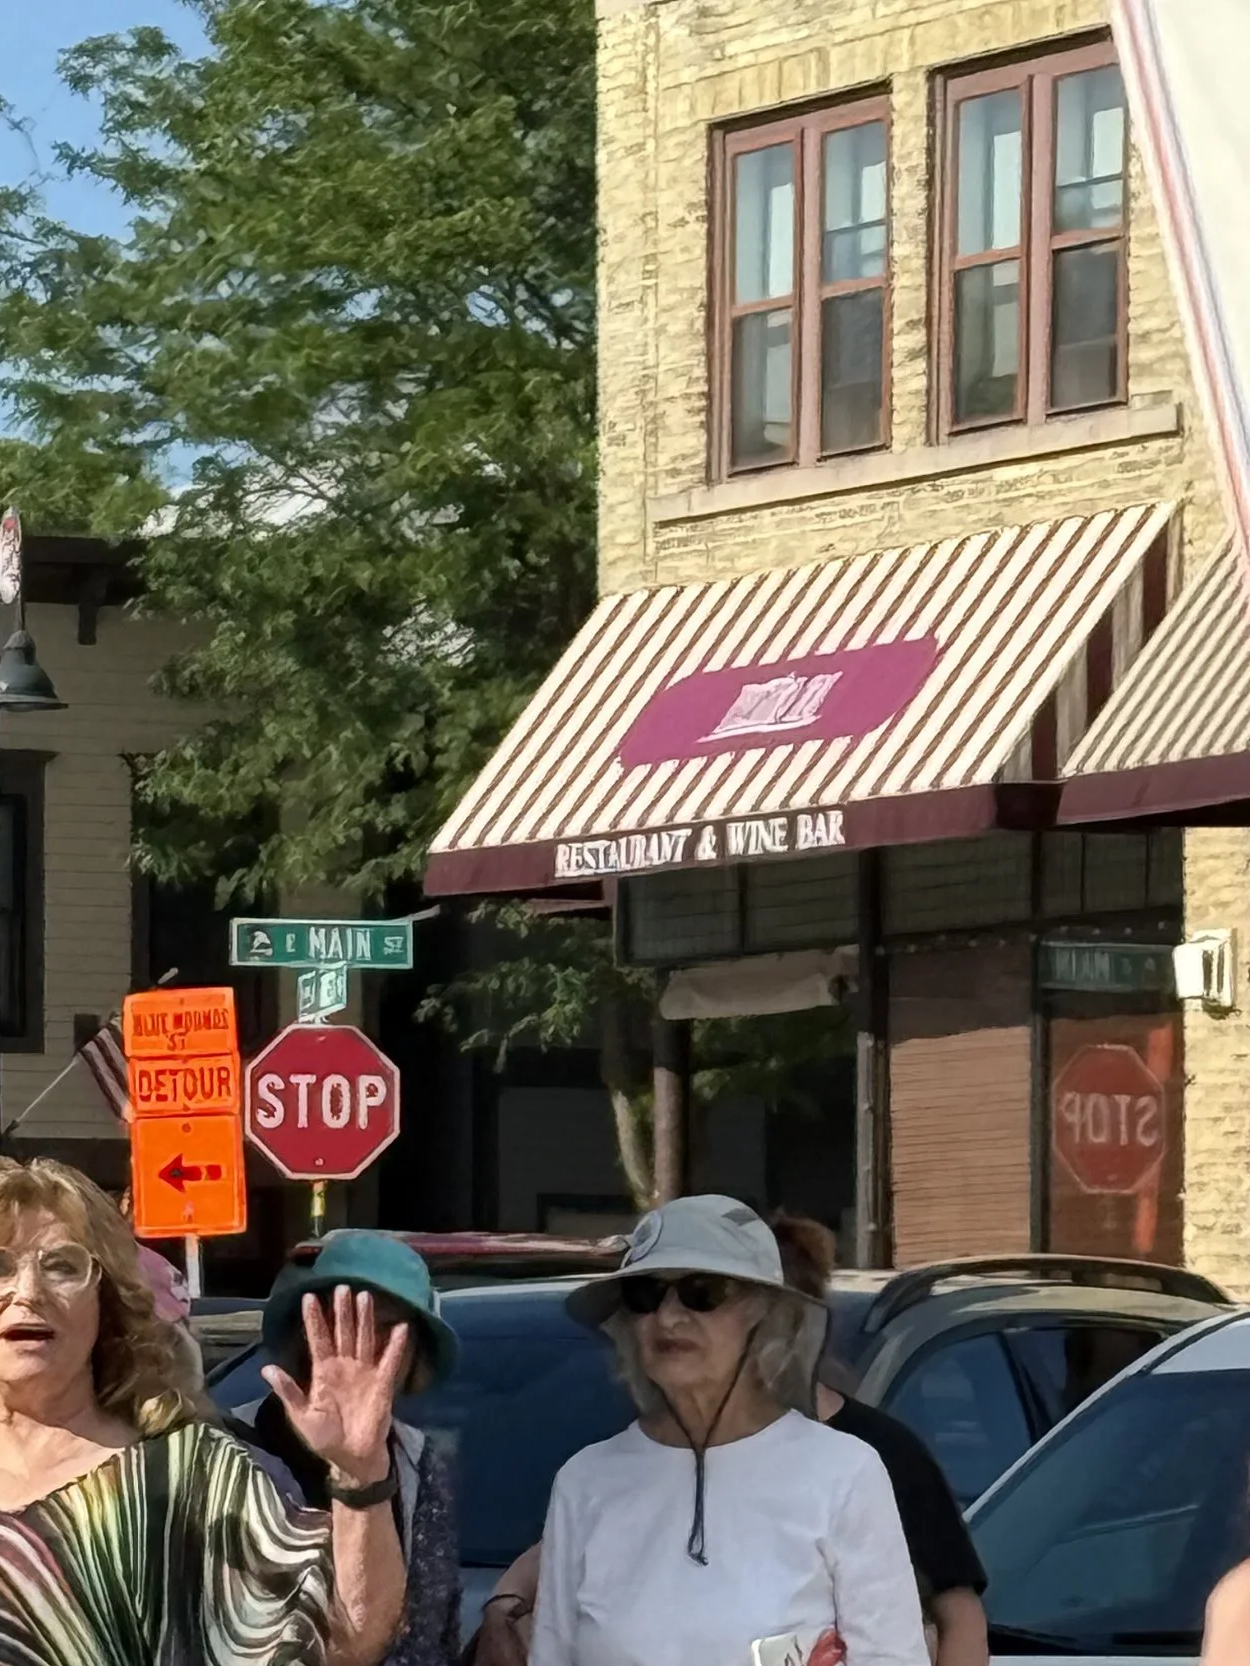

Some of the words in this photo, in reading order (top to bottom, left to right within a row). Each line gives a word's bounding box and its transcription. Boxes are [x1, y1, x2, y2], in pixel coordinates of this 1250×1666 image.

[554, 828, 692, 878] RESTAURANT
[694, 825, 718, 861] &
[726, 817, 789, 856] WINE
[796, 811, 846, 850] BAR
[308, 926, 372, 961] MAIN
[138, 1066, 231, 1102] DETOUR
[256, 1073, 387, 1130] STOP
